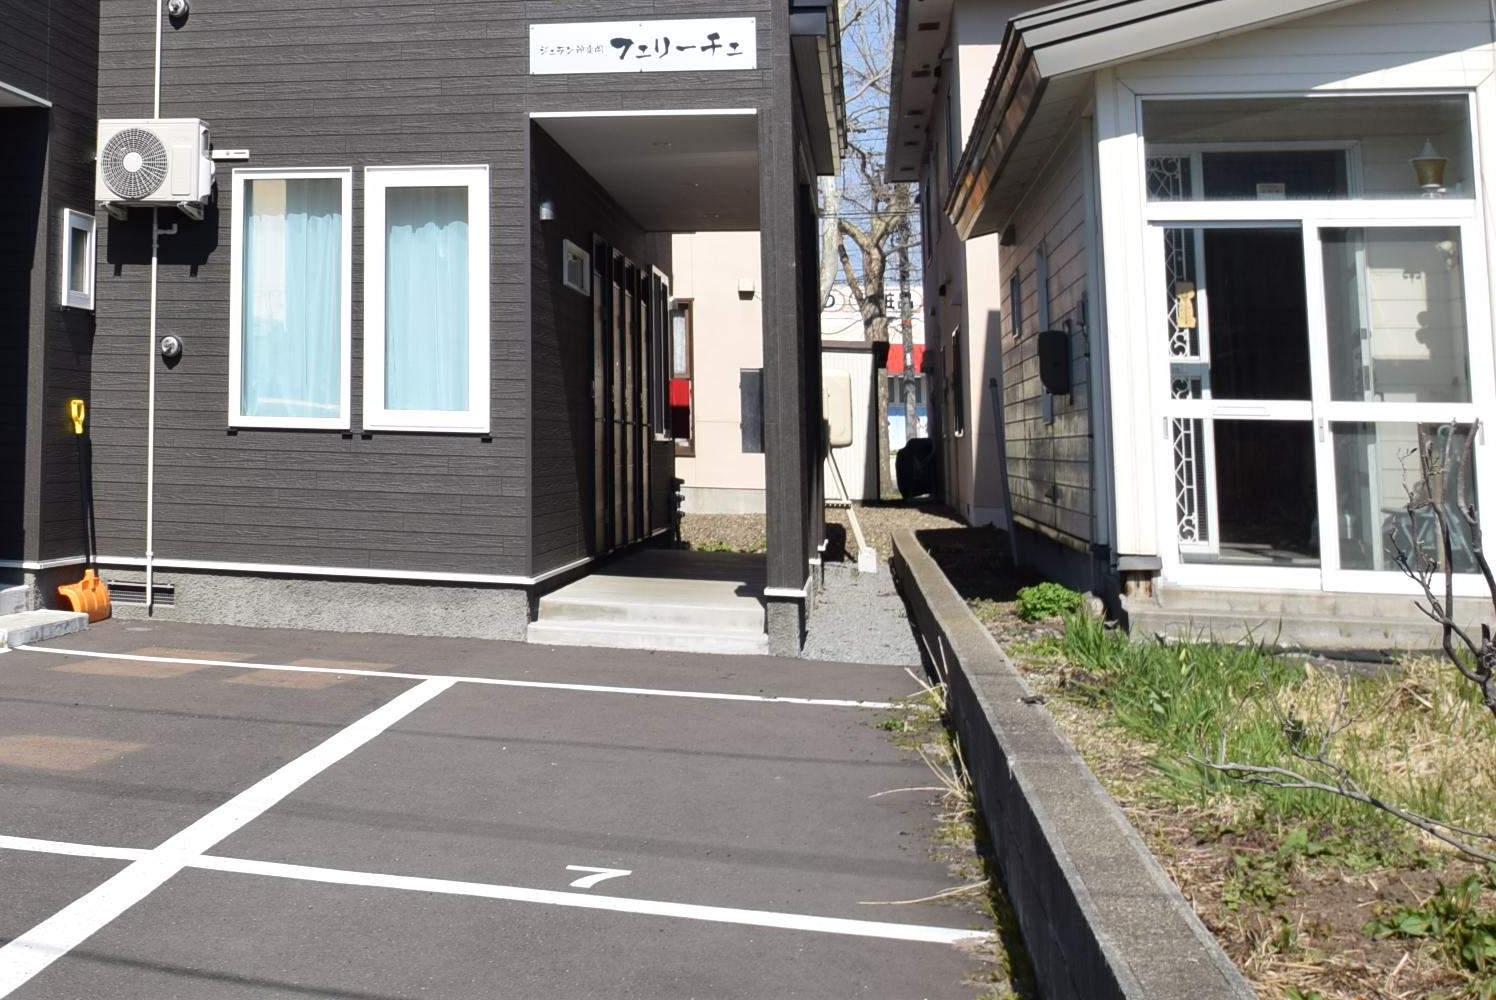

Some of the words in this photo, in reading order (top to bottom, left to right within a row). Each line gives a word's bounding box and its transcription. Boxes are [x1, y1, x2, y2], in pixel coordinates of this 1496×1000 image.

[610, 32, 743, 60] フェリーチェ
[565, 864, 632, 889] 7
